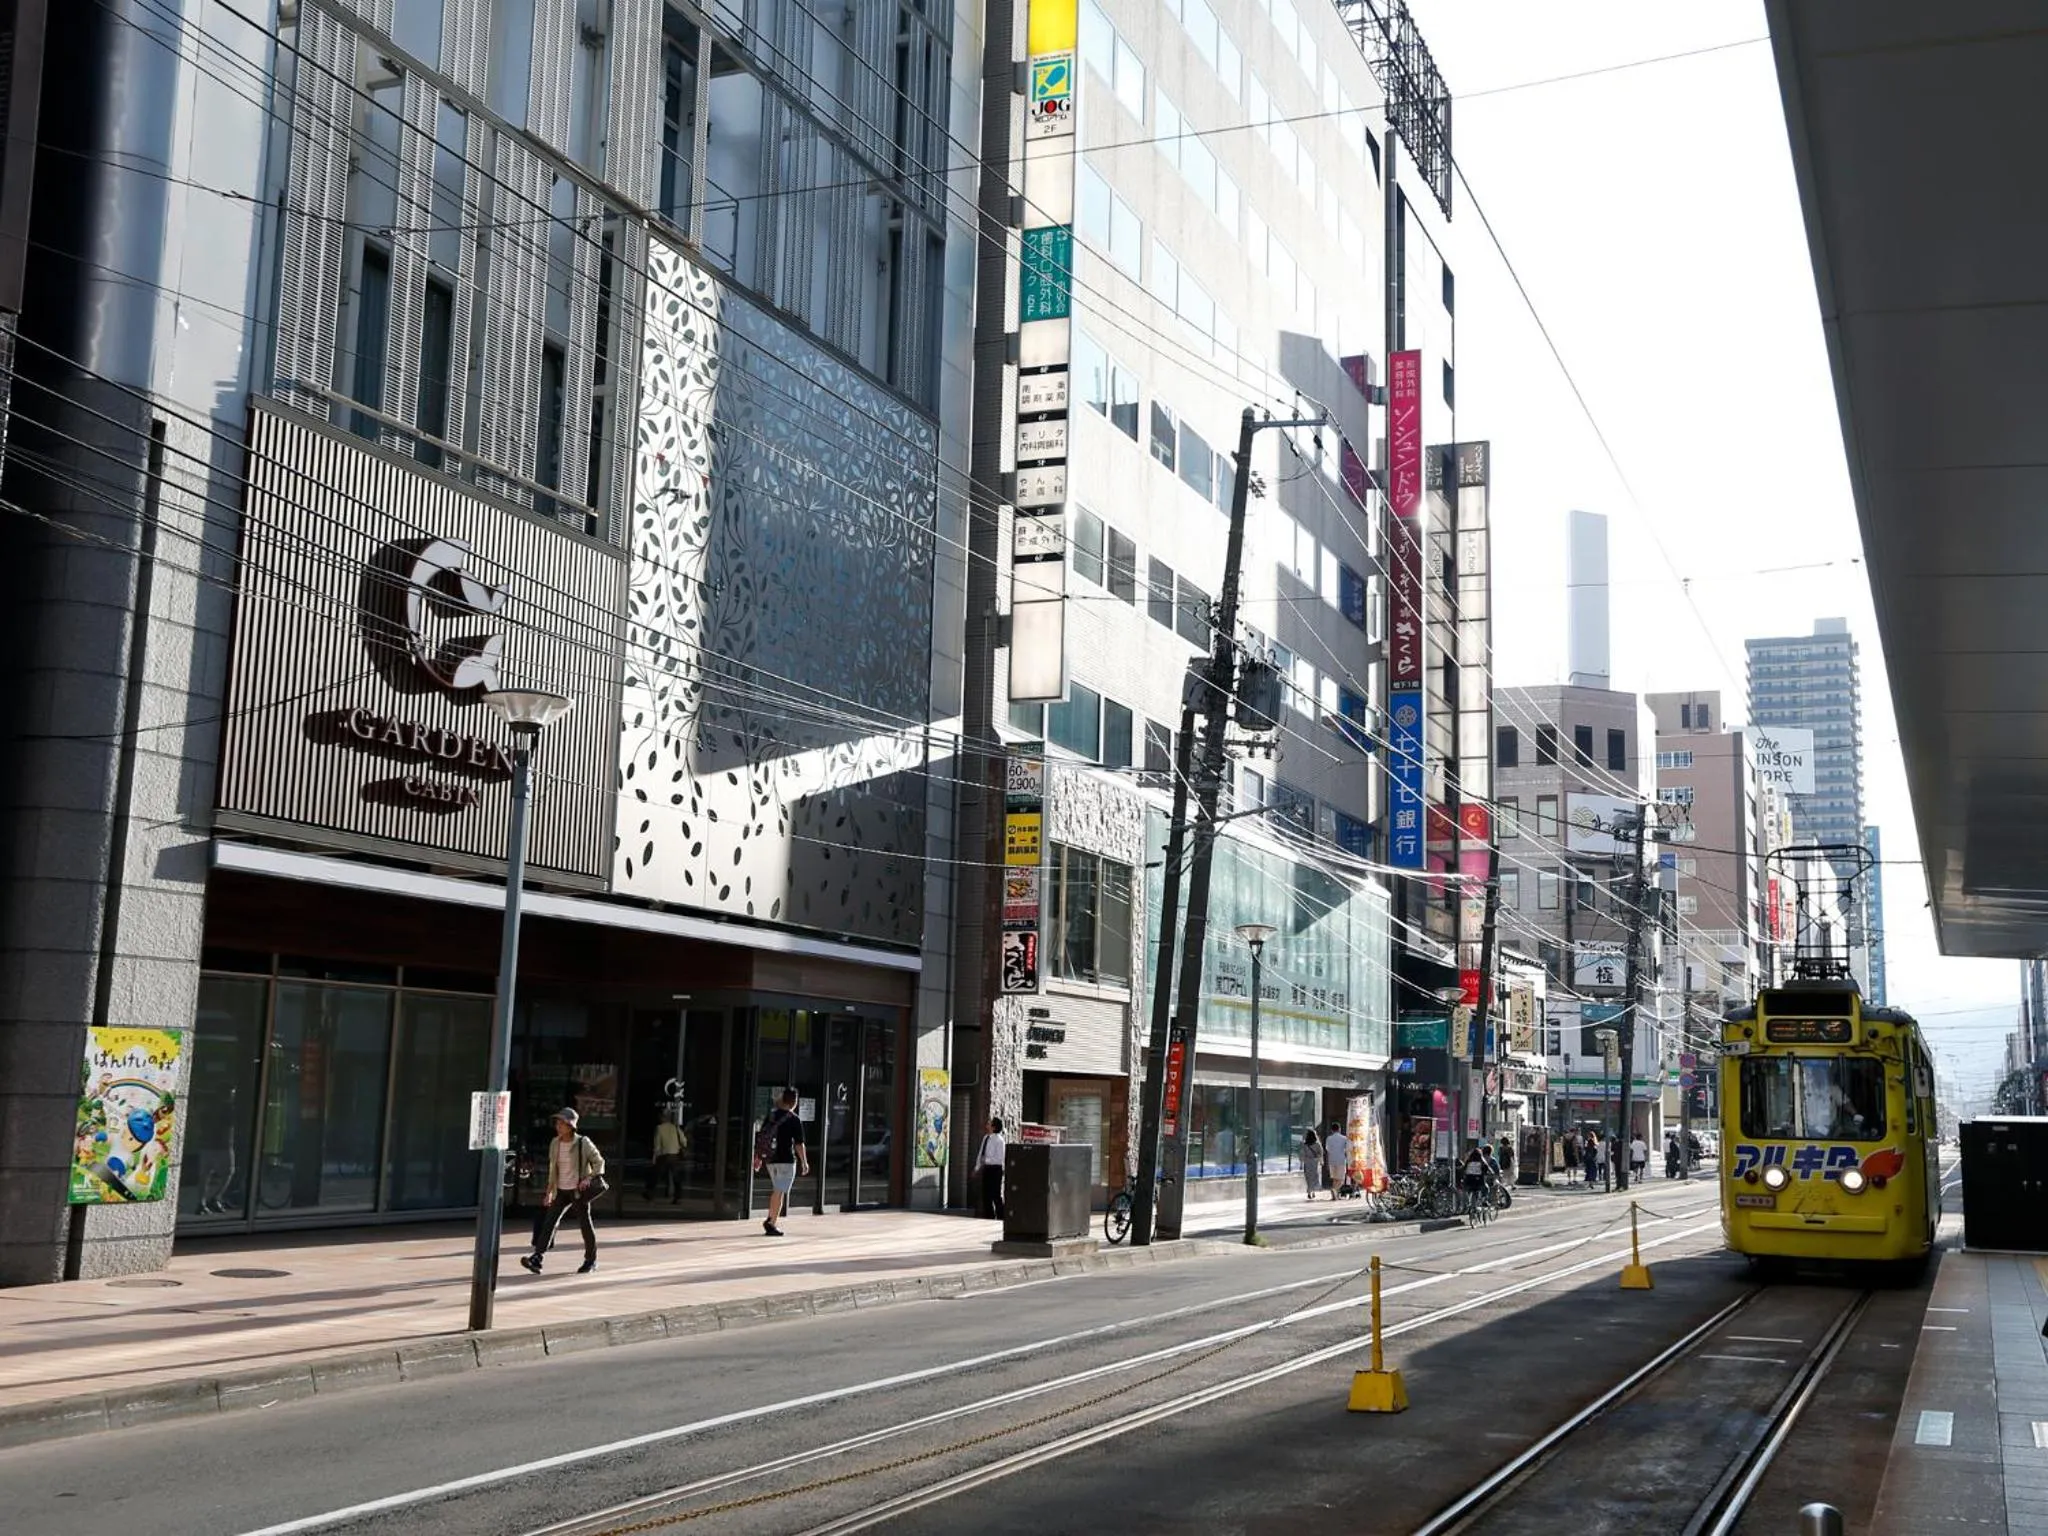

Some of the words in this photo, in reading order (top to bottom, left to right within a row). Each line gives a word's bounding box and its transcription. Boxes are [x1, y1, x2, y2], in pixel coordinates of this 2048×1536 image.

[1032, 98, 1070, 117] JOG
[1043, 124, 1057, 135] 2F
[1755, 737, 1780, 749] The
[404, 774, 481, 809] CABIN
[1395, 733, 1418, 856] 七十七銀行
[1595, 965, 1614, 985] 極
[94, 1048, 176, 1072] ばんけいの森
